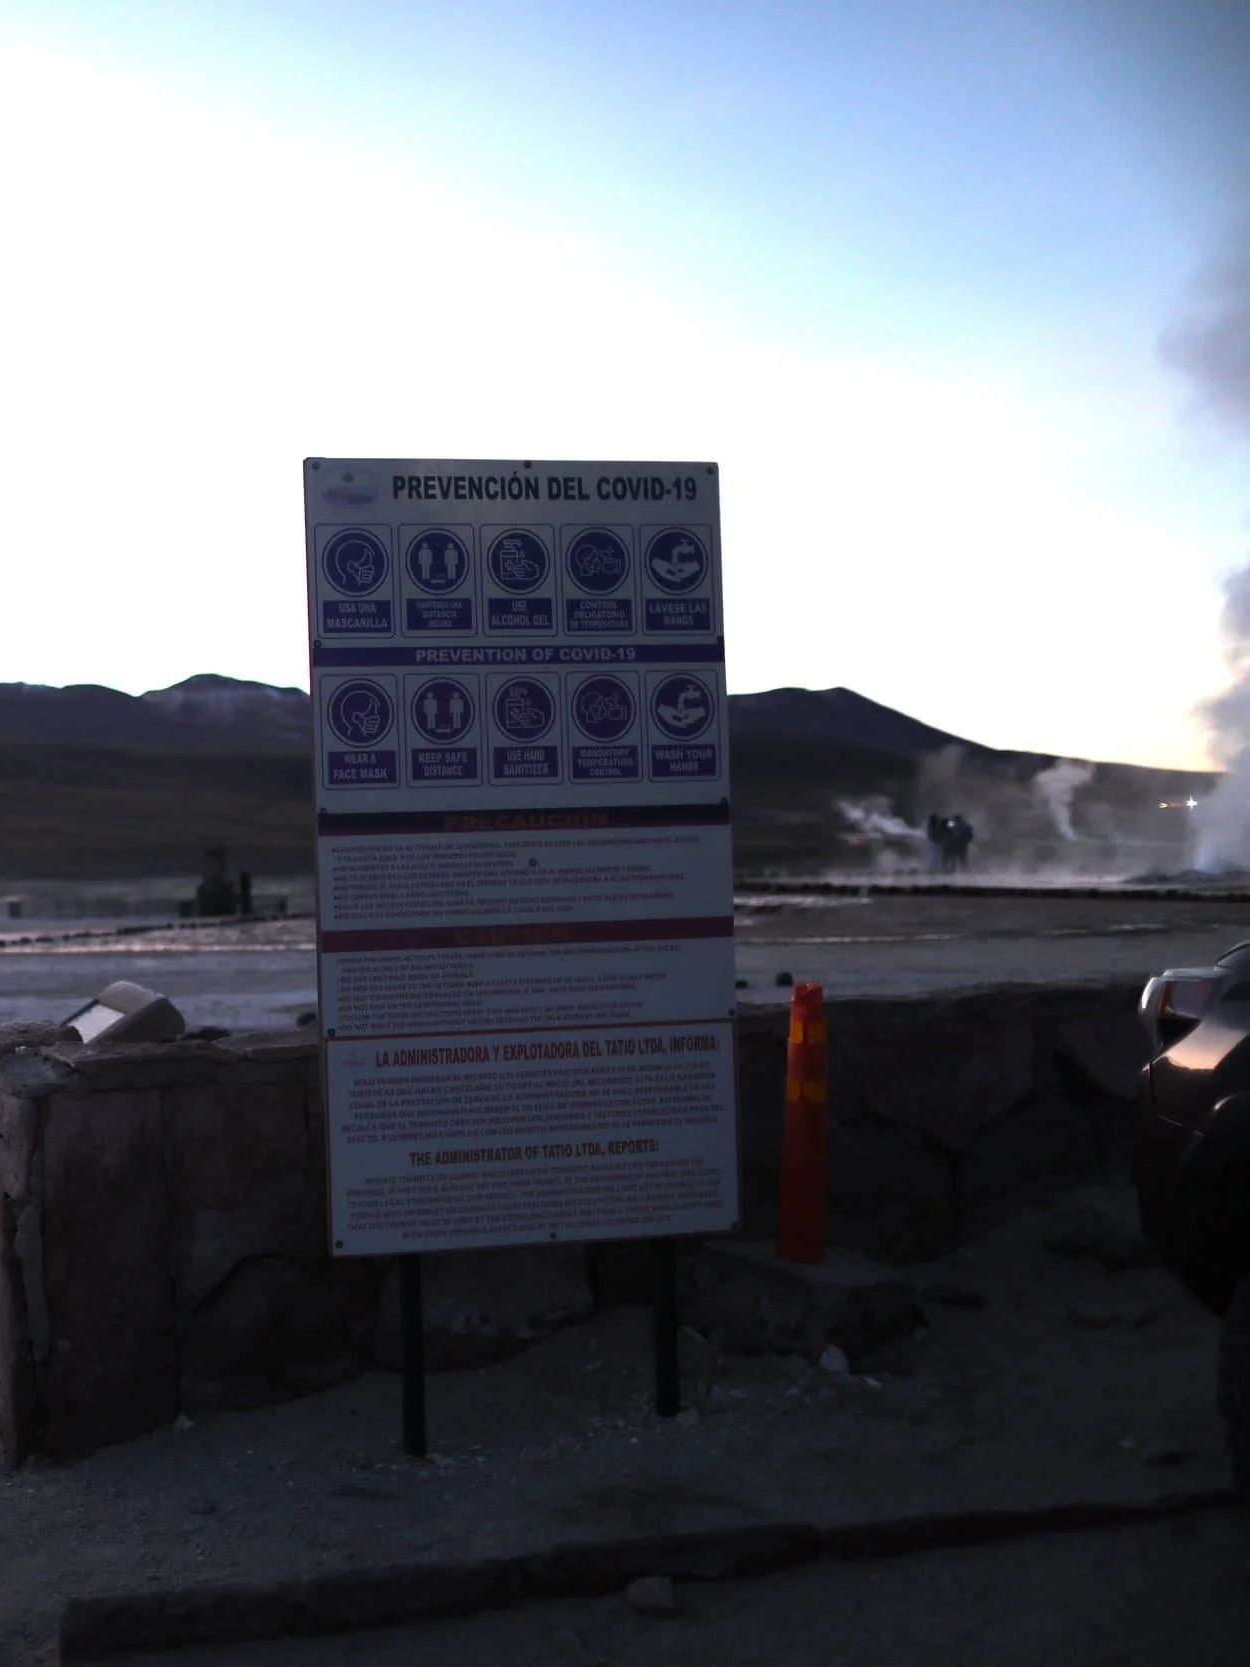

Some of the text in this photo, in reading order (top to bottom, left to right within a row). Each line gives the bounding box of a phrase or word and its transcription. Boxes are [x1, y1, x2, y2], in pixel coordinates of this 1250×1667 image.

[393, 471, 697, 501] PREVENCIÓN DEL COVID-19
[580, 600, 618, 609] CONTROL
[327, 617, 388, 628] MASCARILLA
[491, 615, 551, 627] ALCOHOL GEL
[664, 616, 693, 625] MANOS
[416, 647, 636, 663] PREVENTION OF COVID-19
[344, 753, 377, 764] WEAR A
[419, 752, 442, 763] KEEP
[655, 748, 712, 760] WASH YOUR
[333, 768, 387, 780] FACE MASK
[424, 765, 463, 776] DISTANCE
[504, 764, 549, 775] SANITIZER
[375, 1050, 390, 1068] LA
[392, 1047, 490, 1067] ADMINISTRADORA
[493, 1046, 501, 1062] Y
[503, 1042, 580, 1061] EXPLOTADORA
[582, 1041, 603, 1058] DEL
[605, 1039, 636, 1057] TATIO
[670, 1035, 720, 1053] INFORMA:
[410, 1151, 431, 1167] THE
[435, 1147, 522, 1165] ADMINISTRATOR
[524, 1146, 539, 1161] OF
[542, 1144, 573, 1160] TATIO
[608, 1139, 660, 1155] REPORTS:
